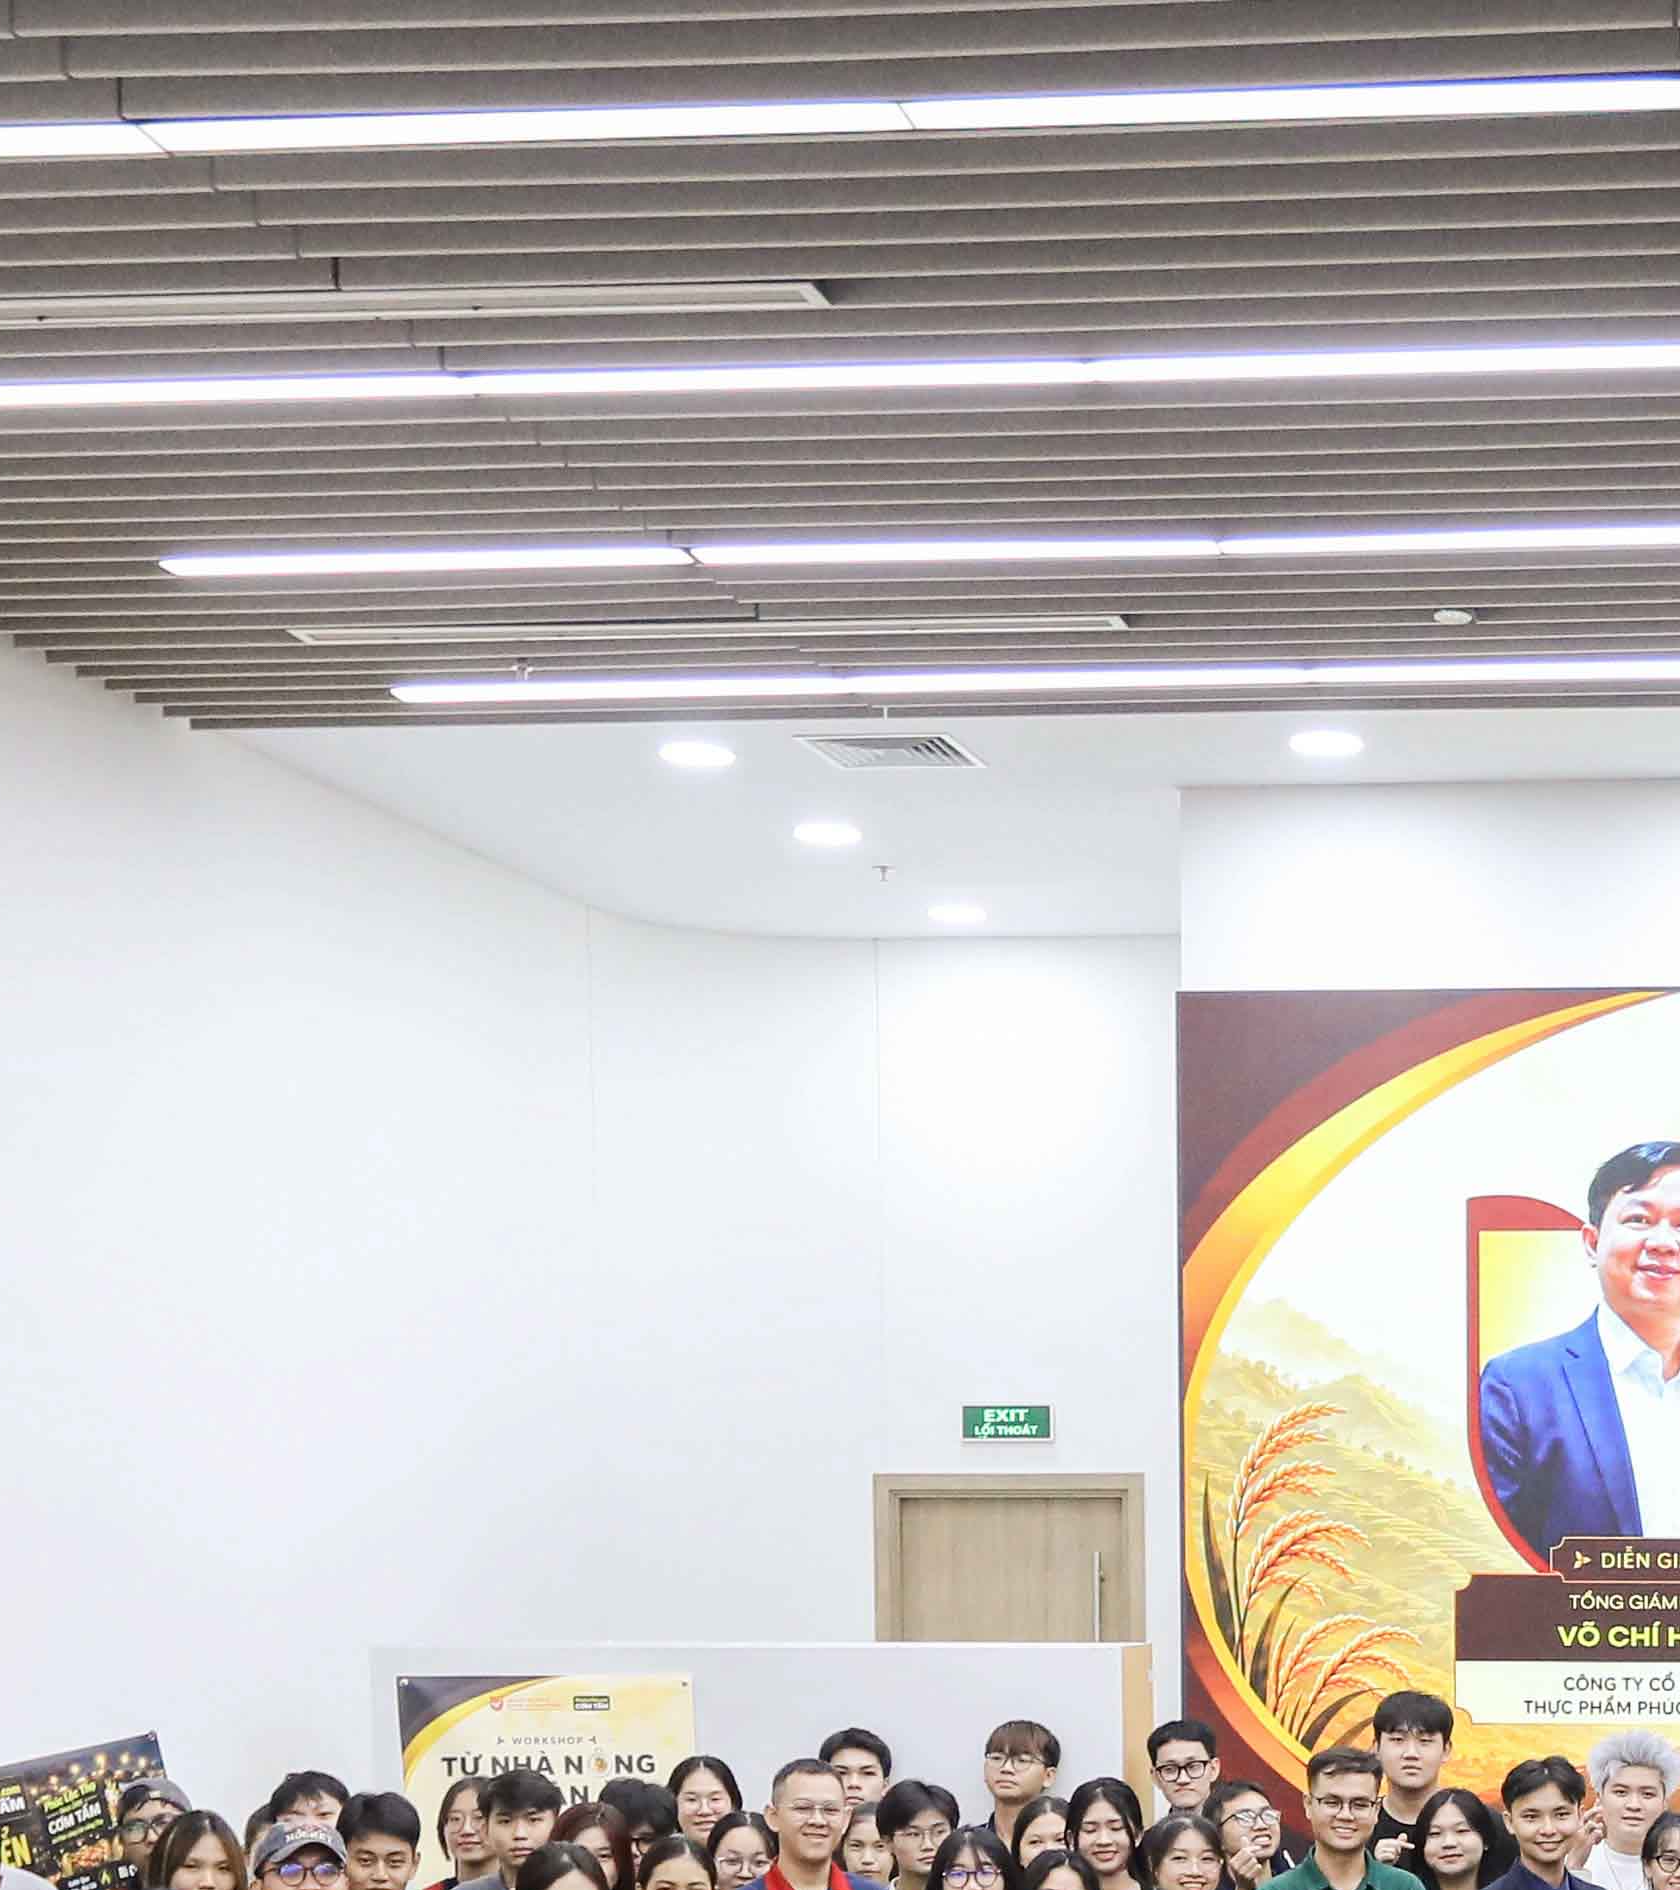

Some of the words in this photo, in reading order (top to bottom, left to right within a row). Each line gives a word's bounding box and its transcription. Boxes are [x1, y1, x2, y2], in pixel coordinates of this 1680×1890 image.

[984, 1409, 1028, 1422] EXIT
[1601, 1546, 1651, 1569] DIỄN
[1628, 1590, 1678, 1611] GIÁM
[1558, 1620, 1601, 1648] VÕ
[1608, 1620, 1661, 1648] CHÍ
[1563, 1675, 1617, 1692] CÔNG
[1622, 1677, 1646, 1691] TY
[441, 1752, 482, 1776] TỪ
